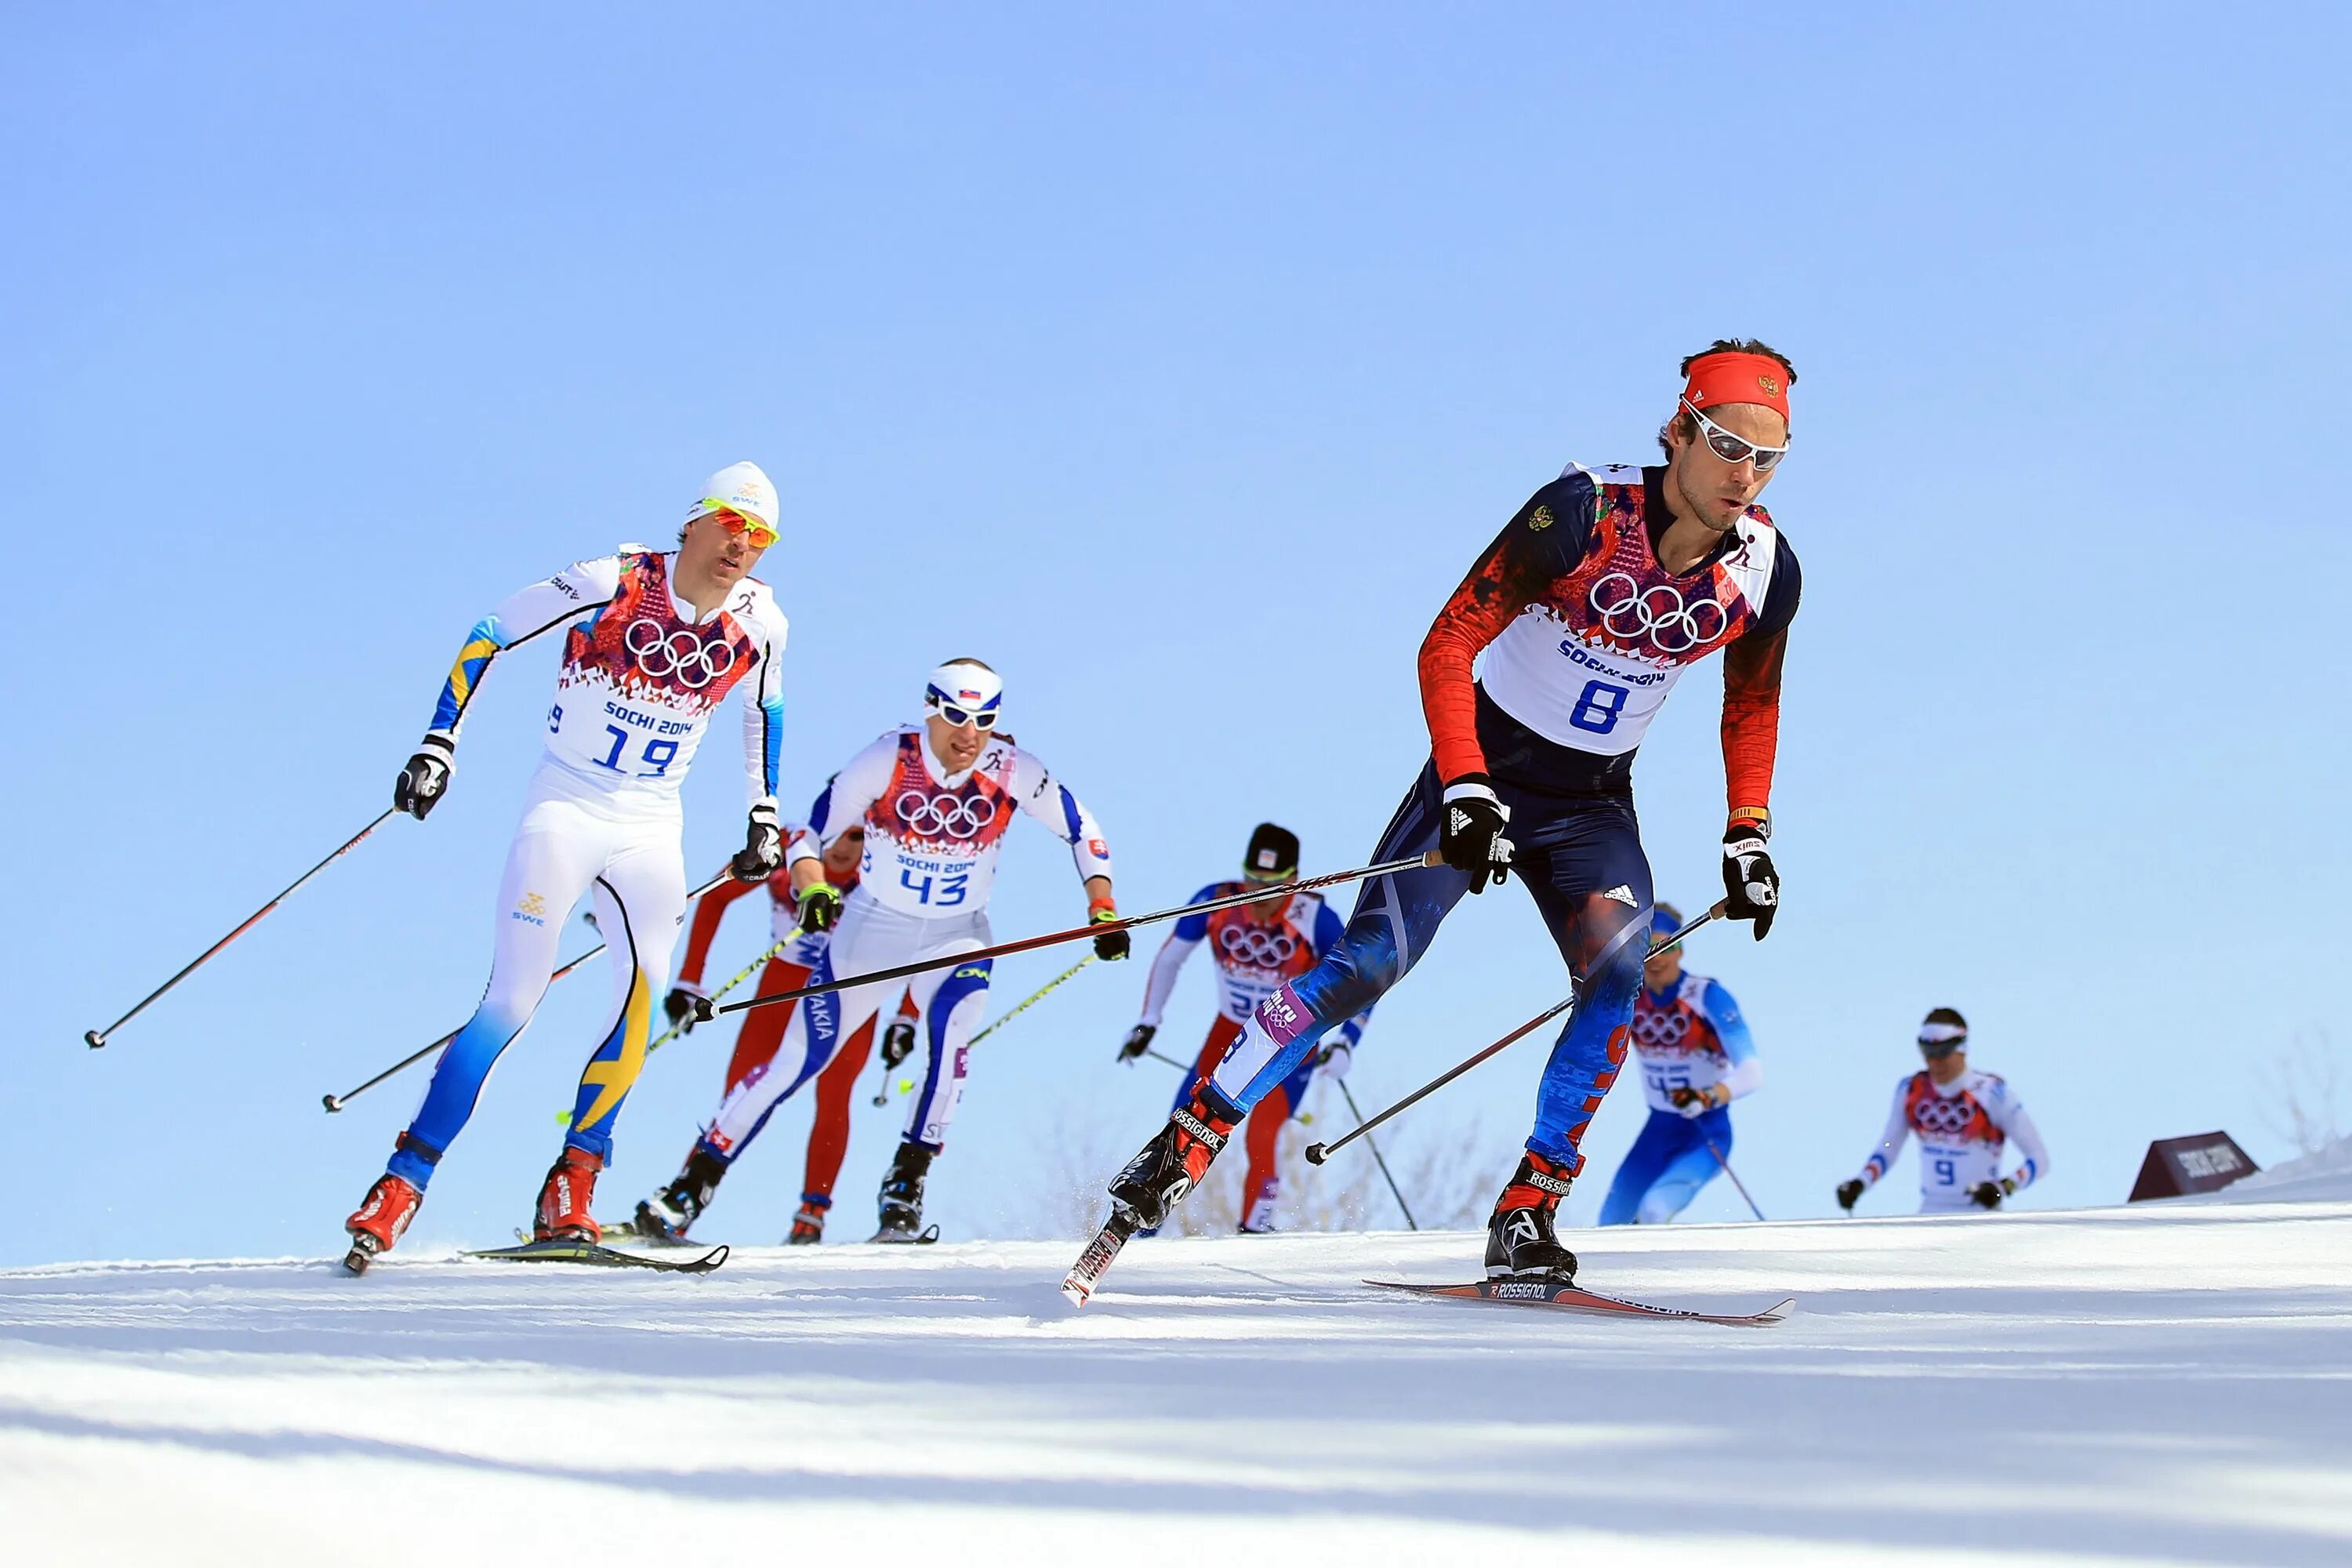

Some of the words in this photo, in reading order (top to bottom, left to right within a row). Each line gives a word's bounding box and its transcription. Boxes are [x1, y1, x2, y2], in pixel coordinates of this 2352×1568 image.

[603, 701, 655, 730] SOCHI
[657, 720, 693, 735] 2014
[1570, 679, 1630, 735] 8
[592, 724, 679, 777] 19
[1488, 831, 1498, 861] adidas
[896, 854, 940, 872] SOCHI
[900, 869, 968, 906] 43
[1603, 892, 1639, 909] adidas
[512, 911, 546, 928] SWE
[1935, 1160, 1955, 1185] 9
[1497, 1283, 1548, 1299] ROSSIGNOL
